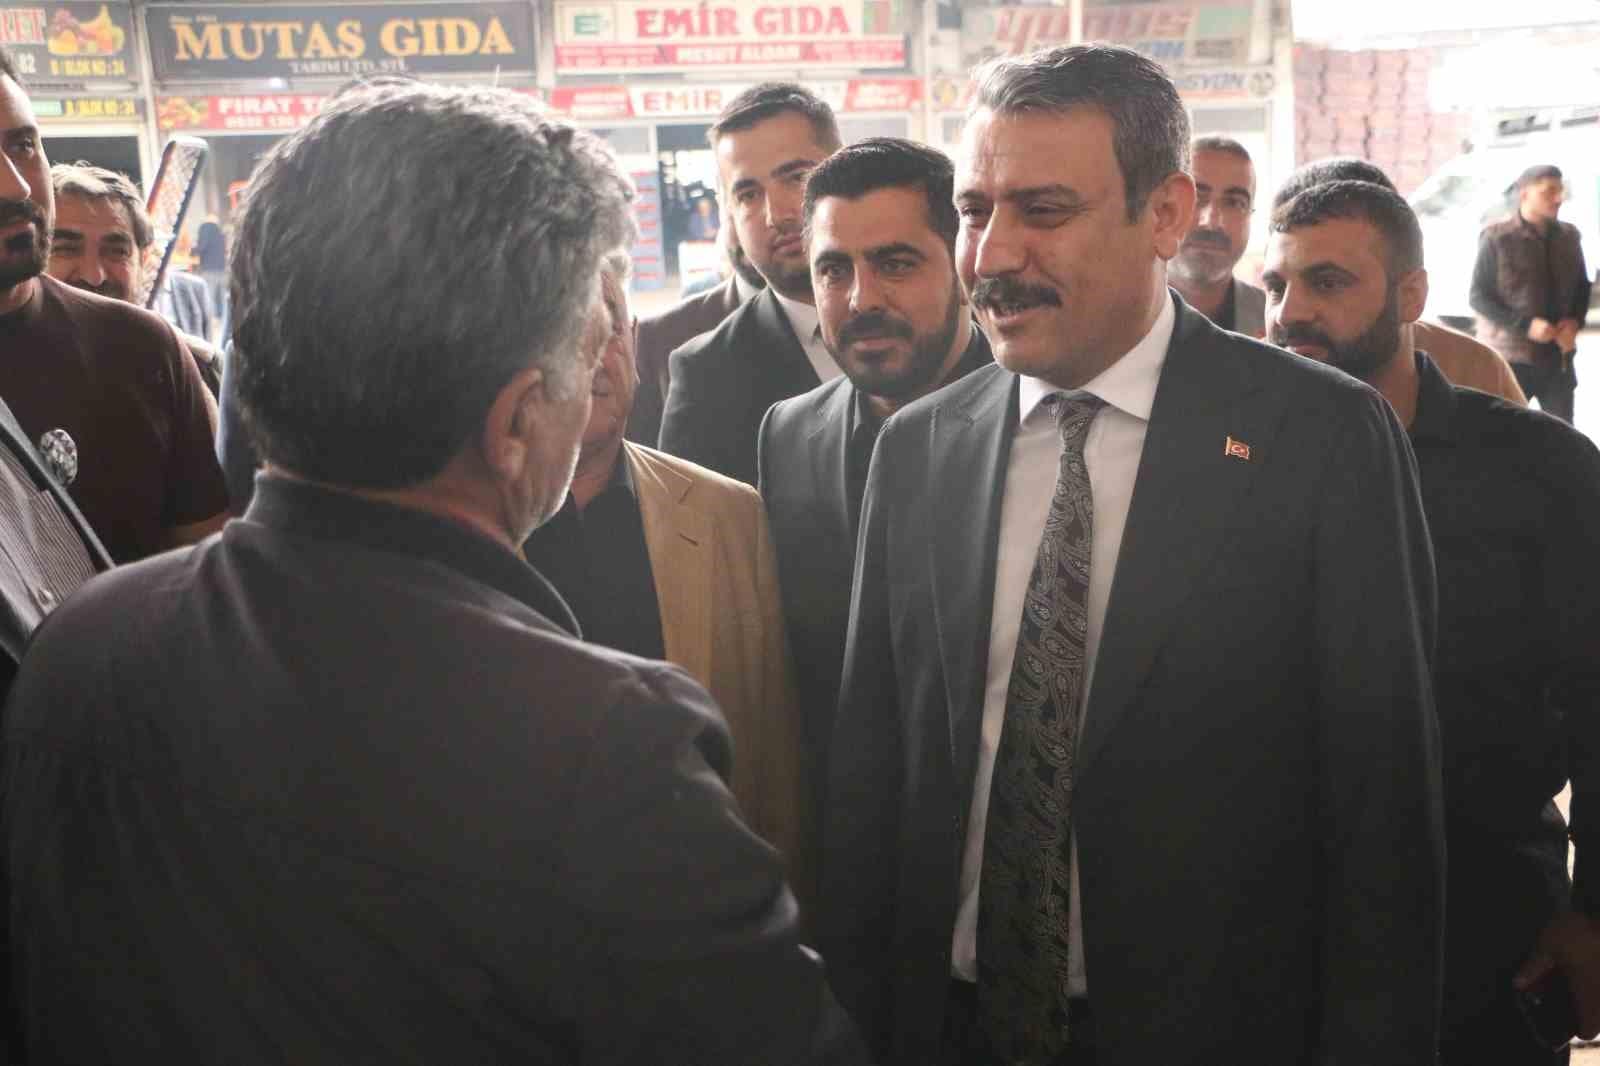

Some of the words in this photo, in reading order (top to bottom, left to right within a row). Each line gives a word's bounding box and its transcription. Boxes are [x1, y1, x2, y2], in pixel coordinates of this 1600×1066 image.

[635, 6, 740, 38] EMİR
[753, 5, 850, 36] GIDA
[174, 20, 367, 62] MUTAS
[379, 17, 514, 57] GIDA
[218, 97, 292, 113] FIRAT
[642, 87, 721, 112] EMİR
